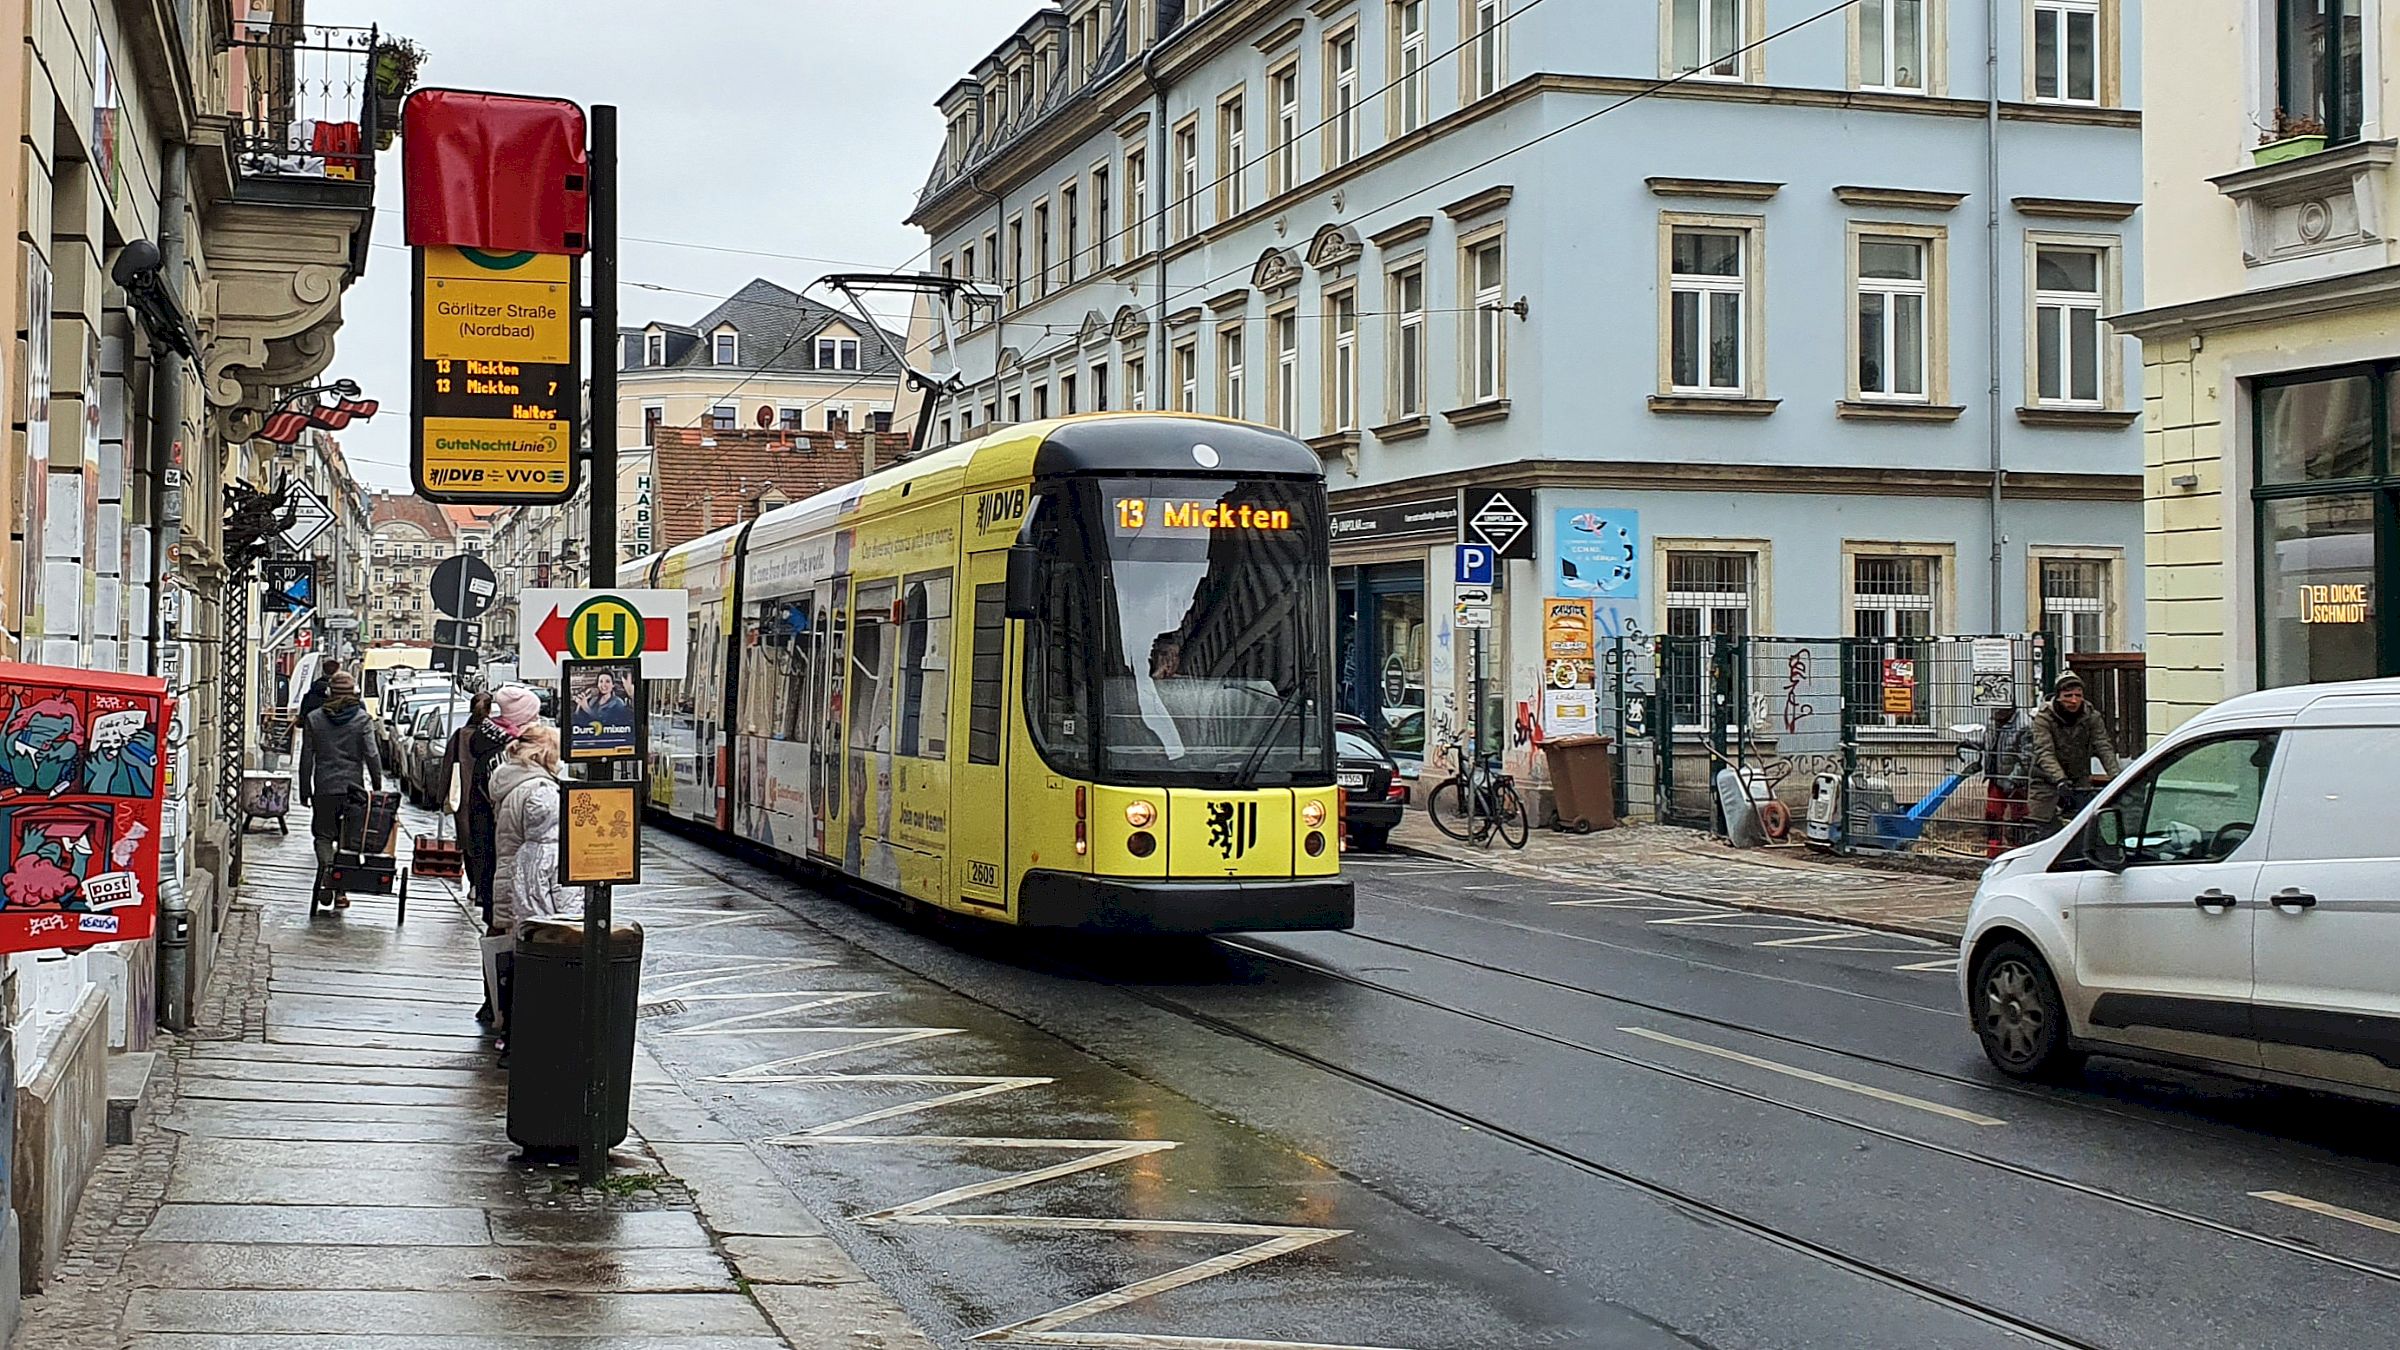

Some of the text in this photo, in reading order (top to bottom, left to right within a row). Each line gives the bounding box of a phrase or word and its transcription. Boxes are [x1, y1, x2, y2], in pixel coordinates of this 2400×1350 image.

[438, 301, 557, 319] Görlitzer Straße
[459, 322, 535, 341] (Nordbad)
[435, 359, 519, 376] 13 Mickten
[435, 378, 557, 396] 13 Mickten 7
[436, 437, 545, 453] GuteNachtLinie
[448, 468, 485, 482] DVB
[506, 469, 546, 483] VVO
[992, 489, 1024, 521] DVB
[1115, 499, 1290, 530] 13 Mickten
[1463, 548, 1485, 579] P
[2331, 584, 2368, 603] DICKE
[2314, 603, 2368, 623] SCHMIDT
[585, 612, 626, 656] H
[972, 862, 995, 885] 2609
[92, 876, 129, 896] post
